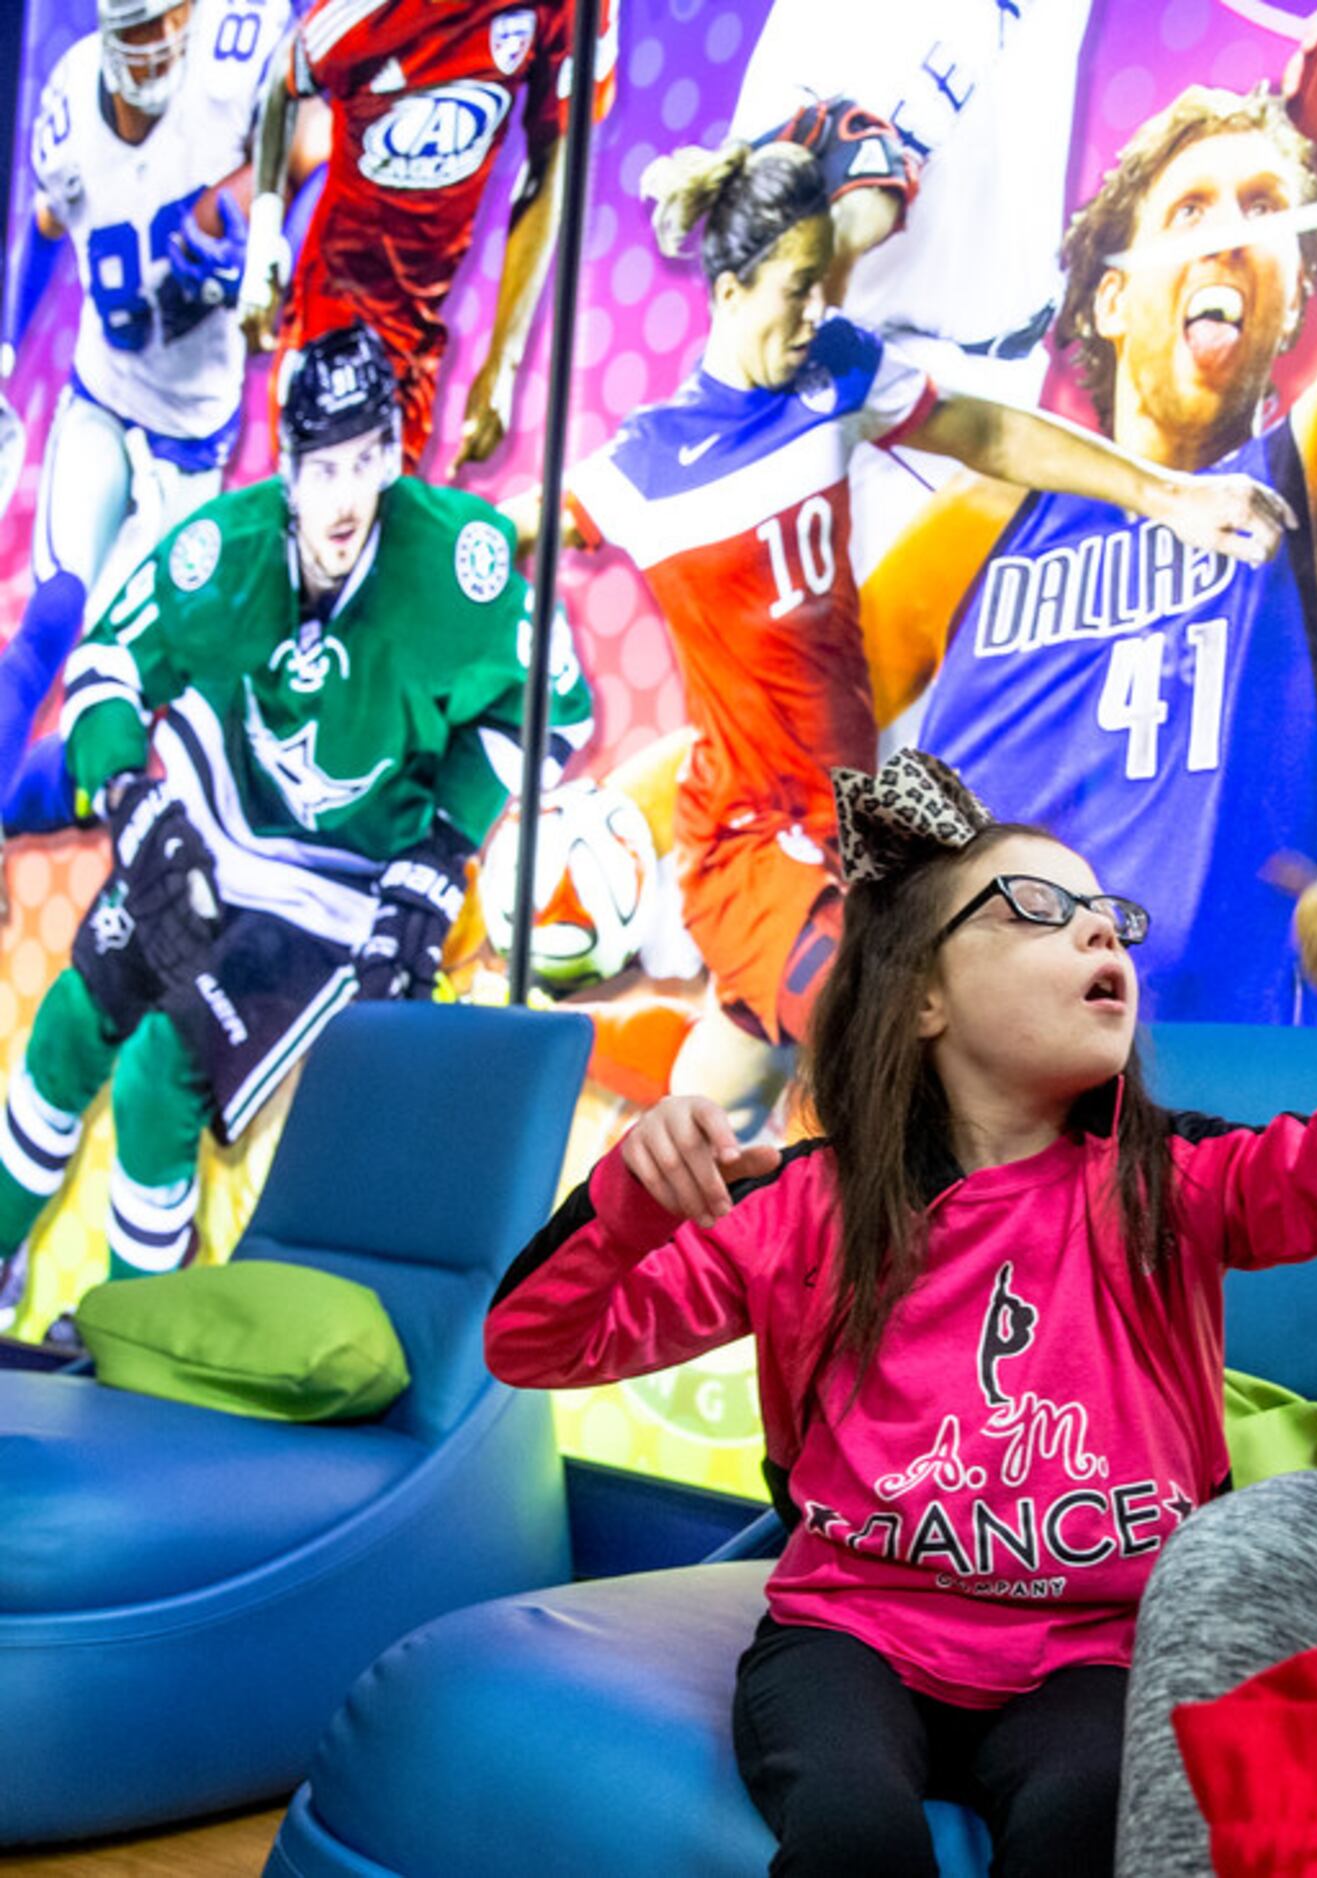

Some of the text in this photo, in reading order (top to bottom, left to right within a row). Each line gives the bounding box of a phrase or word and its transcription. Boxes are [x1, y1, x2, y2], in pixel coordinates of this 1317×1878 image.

[757, 494, 837, 620] 10
[974, 518, 1239, 658] DALLAS
[1097, 617, 1229, 781] 41
